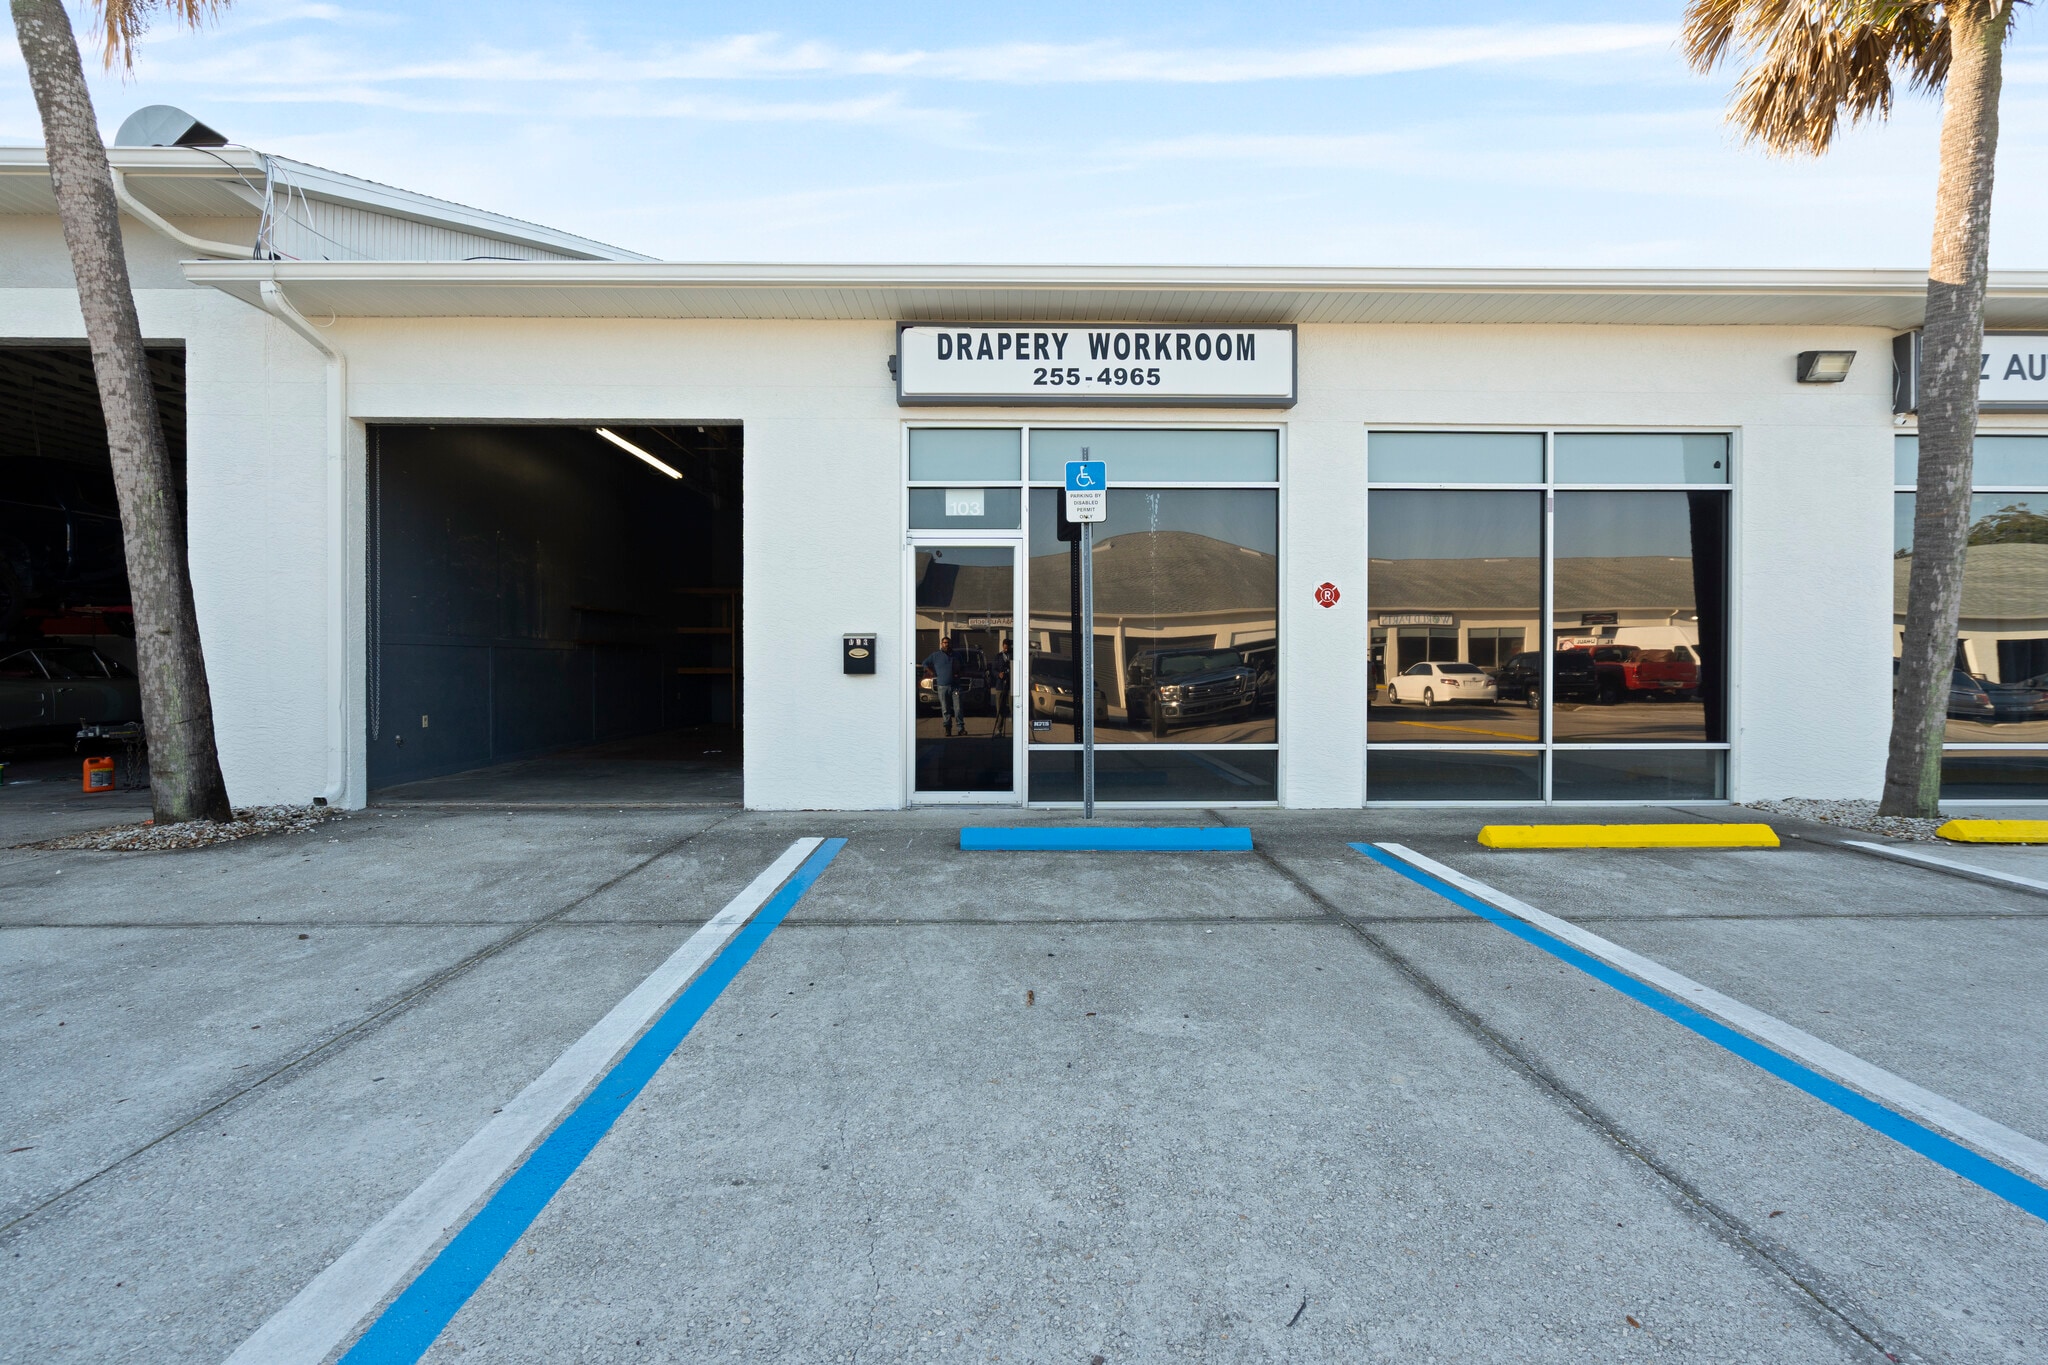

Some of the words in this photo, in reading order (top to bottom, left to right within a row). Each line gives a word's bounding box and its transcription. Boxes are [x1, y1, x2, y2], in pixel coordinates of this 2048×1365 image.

[937, 332, 1069, 361] DRAPERY
[1088, 332, 1257, 361] WORKROOM
[1033, 367, 1161, 386] 255-4965
[2003, 354, 2048, 381] AU
[950, 502, 981, 515] 103
